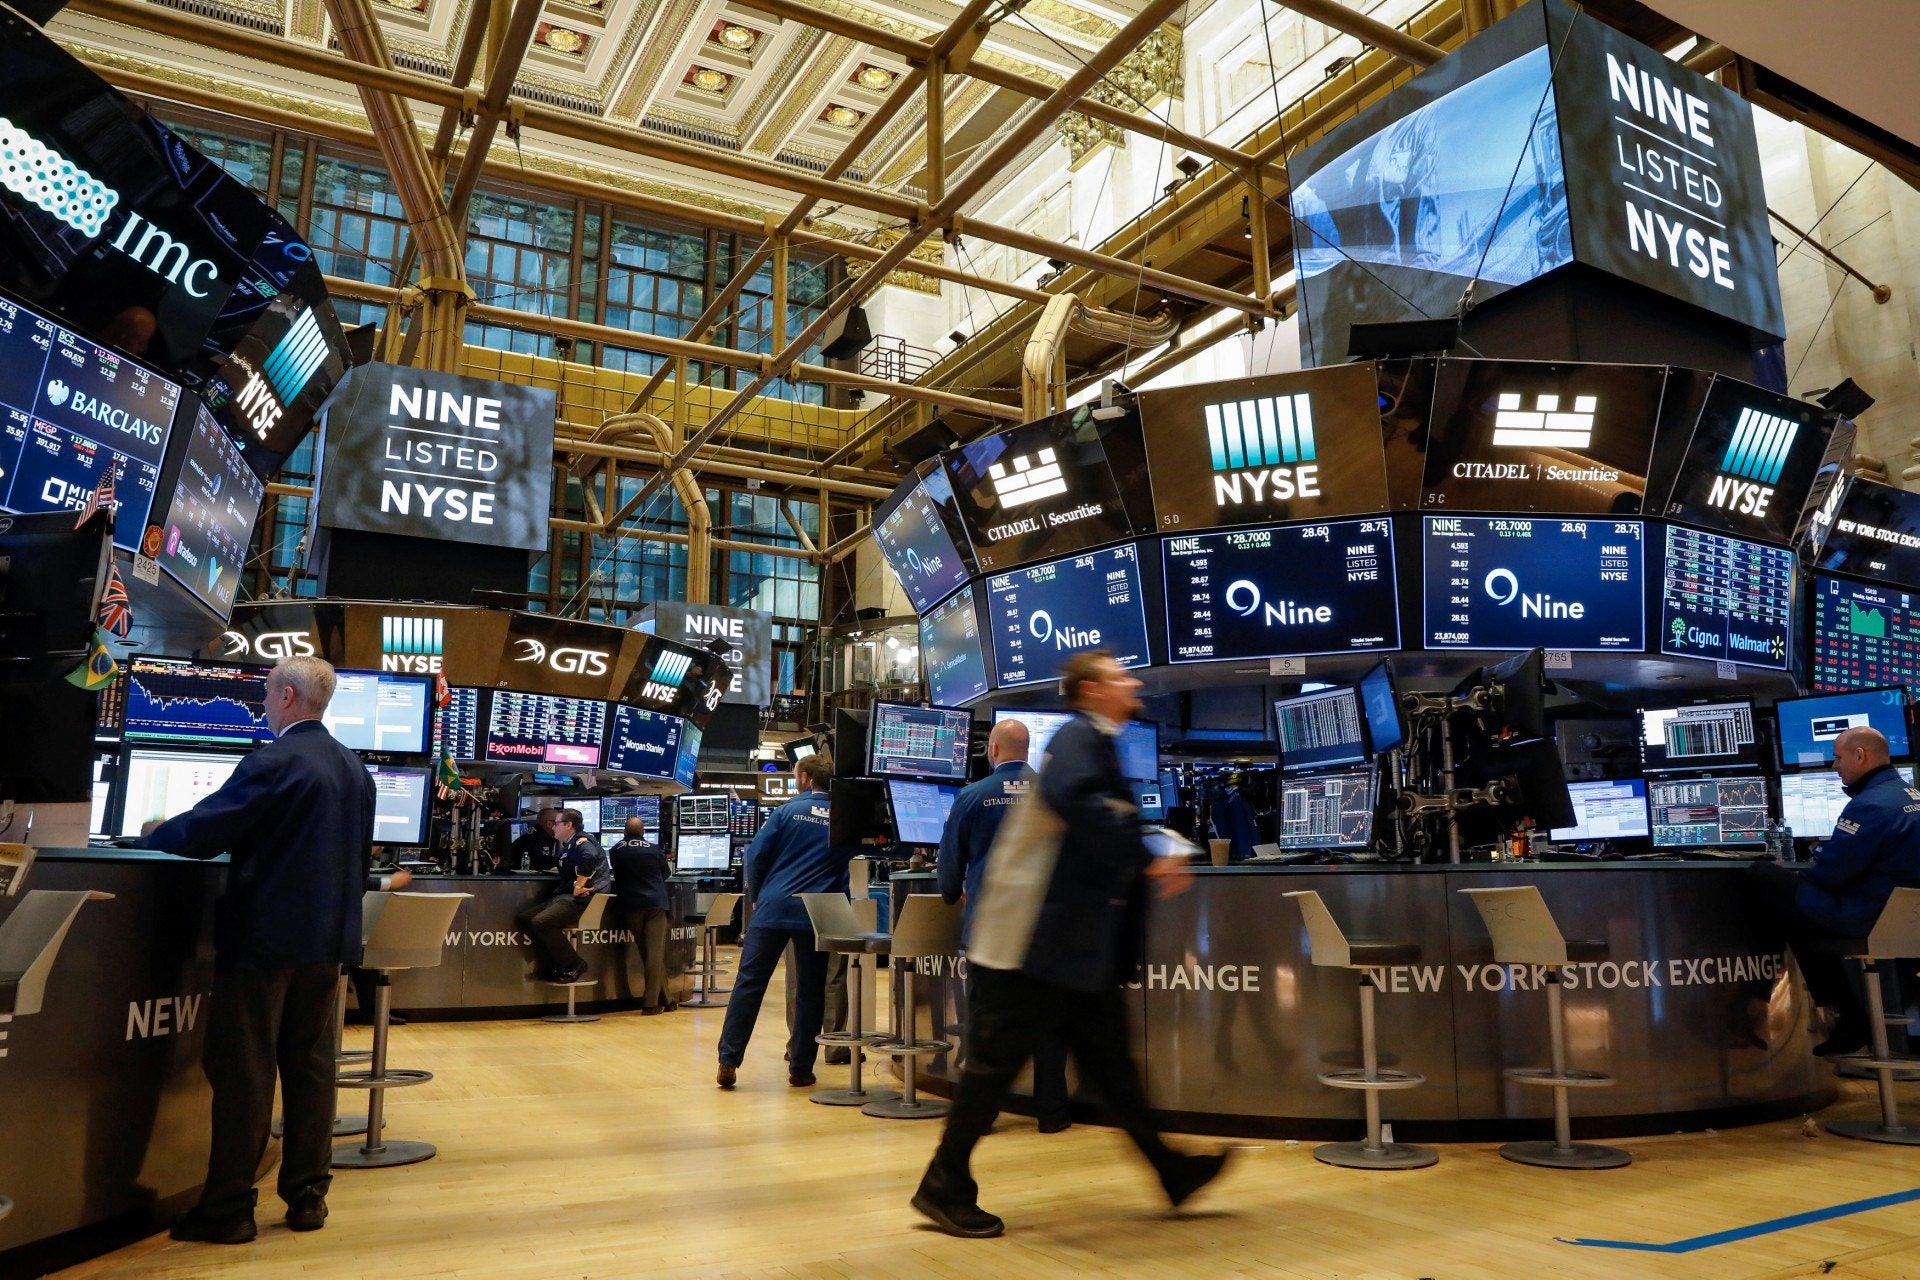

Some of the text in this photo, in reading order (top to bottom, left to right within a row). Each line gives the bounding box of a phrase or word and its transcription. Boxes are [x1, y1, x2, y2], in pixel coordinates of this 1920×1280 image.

[1606, 53, 1714, 147] NINE
[1617, 134, 1722, 208] LISTED
[1625, 200, 1735, 290] NYSE
[59, 330, 76, 345] BCS
[236, 371, 283, 440] NYSE
[389, 383, 502, 431] NINE
[34, 420, 57, 434] MFGP
[70, 390, 162, 445] BARCLAYS
[385, 437, 498, 472] LISTED
[1453, 463, 1619, 482] CITADEL Securities
[1213, 465, 1321, 506] NYSE
[380, 479, 496, 525] NYSE
[1707, 475, 1774, 518] NYSE
[988, 502, 1103, 541] CITADEL Securities
[1432, 519, 1640, 534] NINE 28.7000 28.60 28.75
[1837, 519, 1856, 533] NEW
[1856, 523, 1877, 538] YORK
[1876, 528, 1901, 544] STOCK
[1170, 521, 1388, 552] NINE 28.7000 28.60 28.75
[1347, 545, 1375, 555] NINE
[1601, 545, 1627, 555] NINE
[137, 557, 157, 576] 2425
[922, 556, 943, 578] Nine
[992, 576, 1011, 589] NINE
[1031, 564, 1056, 578] 28.7000
[1075, 556, 1094, 568] 28.60
[1114, 546, 1134, 559] 28.75
[1346, 558, 1377, 568] LISTED
[1450, 560, 1469, 568] 28.67
[1600, 559, 1628, 568] LISTED
[1106, 569, 1126, 581] NINE
[1348, 570, 1378, 582] NYSE
[1450, 578, 1469, 586] 28.74
[1601, 571, 1628, 581] NYSE
[216, 582, 230, 604] VALE
[1107, 582, 1129, 593] LISTED
[1192, 593, 1210, 601] 28.74
[1108, 593, 1130, 606] NYSE
[1451, 596, 1469, 604] 28.44
[1521, 593, 1585, 619] Nine
[1193, 611, 1211, 619] 28.44
[1265, 601, 1332, 626] Nine
[685, 614, 744, 638] NINE
[254, 631, 316, 659] GTS
[1055, 626, 1101, 651] Nine
[1729, 632, 1770, 654] Walmart
[382, 654, 444, 674] NYSE
[549, 647, 610, 676] GTS
[1284, 659, 1291, 668] 5
[642, 681, 678, 703] NYSE
[488, 742, 544, 756] ExxonMobil
[625, 739, 666, 756] Morgan Stanley
[983, 797, 1016, 807] CITADEL
[792, 814, 820, 824] CITADEL
[628, 839, 651, 848] GTS
[468, 931, 519, 946] YORK
[671, 927, 685, 940] NEW
[916, 955, 943, 977] NEW
[1369, 953, 1783, 993] NEW YORK STOCK EXCHANGE
[126, 993, 201, 1041] NEW
